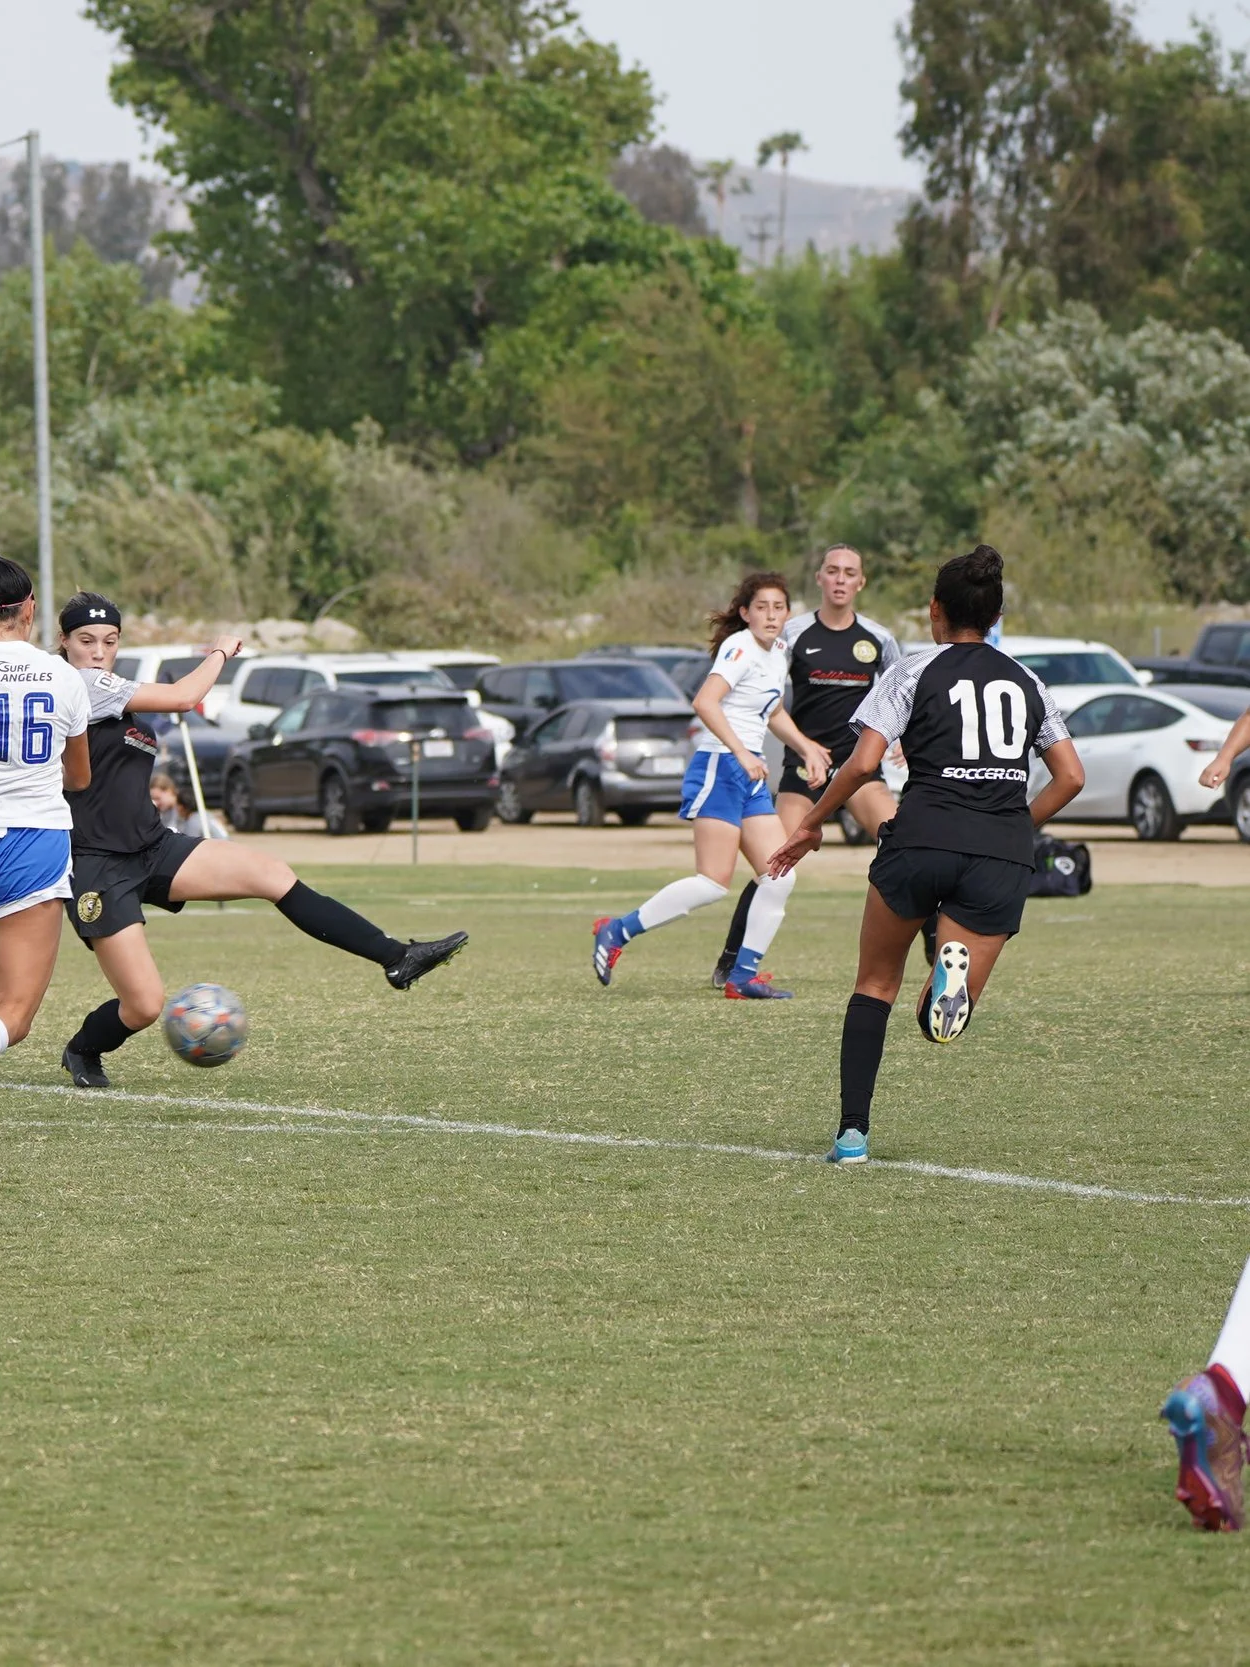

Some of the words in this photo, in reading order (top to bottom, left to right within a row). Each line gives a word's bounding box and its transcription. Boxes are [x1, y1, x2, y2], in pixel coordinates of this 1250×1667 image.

[3, 663, 31, 673] SURF
[0, 672, 53, 683] ANGELES
[948, 679, 1028, 760] 10
